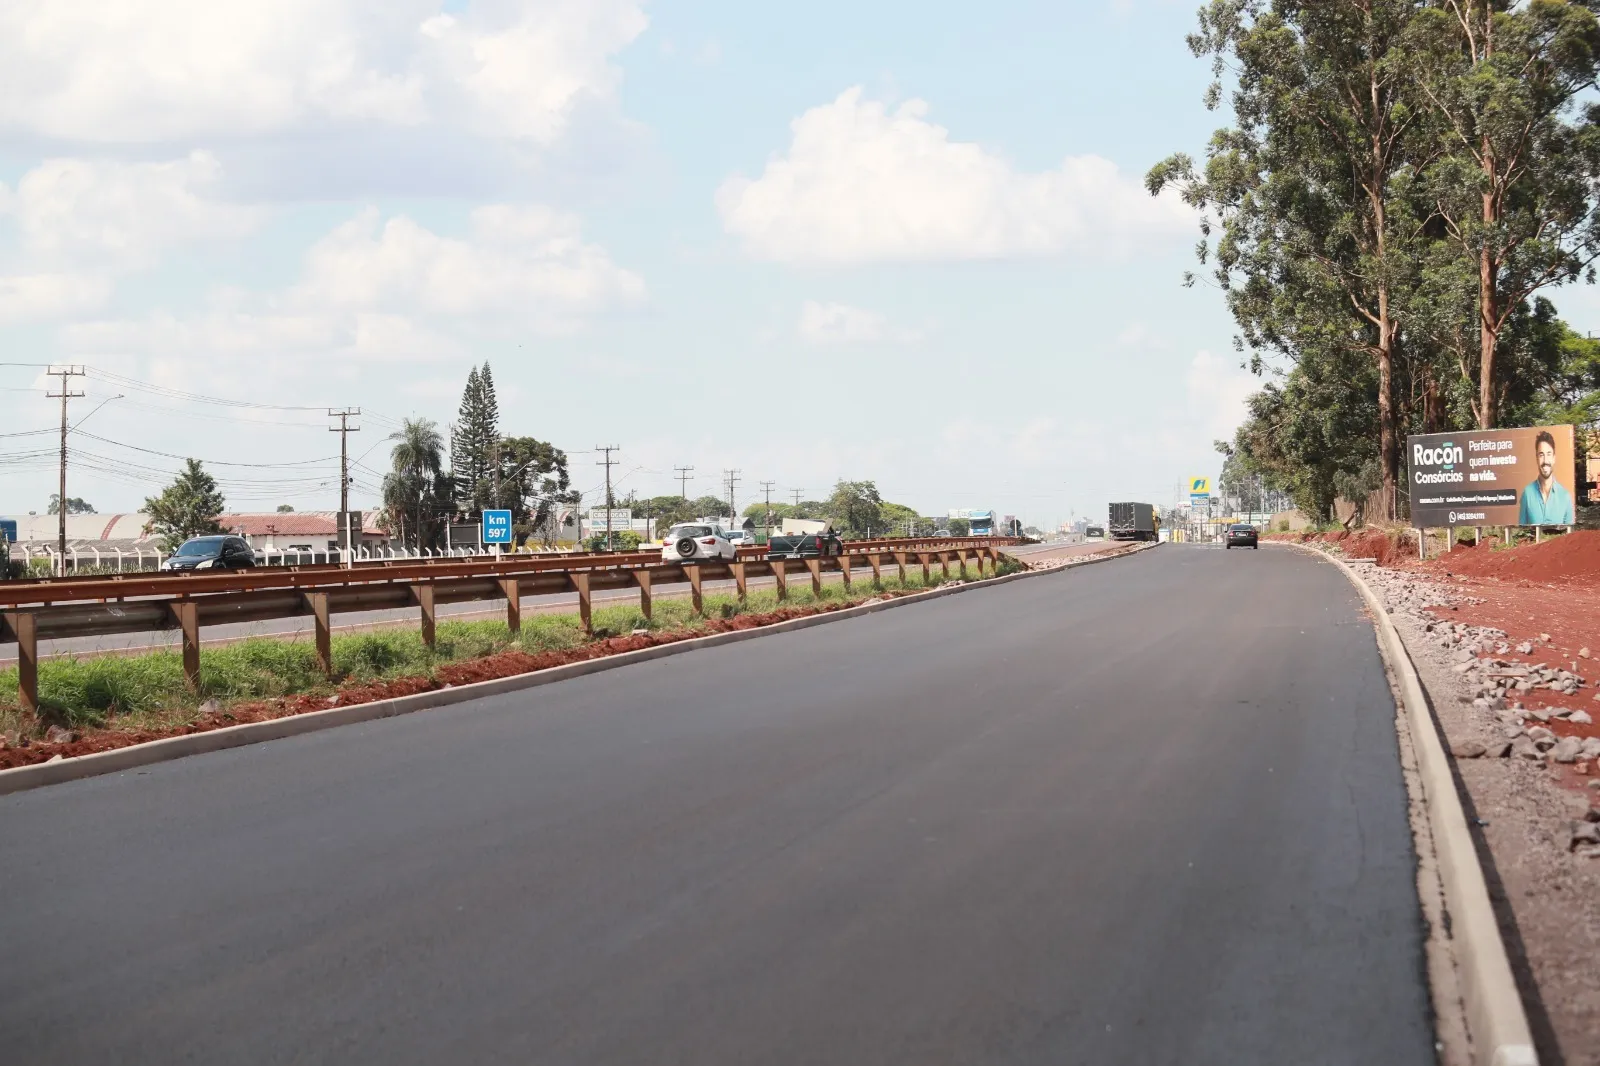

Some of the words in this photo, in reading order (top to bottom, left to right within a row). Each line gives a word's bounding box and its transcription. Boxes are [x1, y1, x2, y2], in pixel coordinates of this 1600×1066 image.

[1468, 440, 1496, 452] Perfeita
[1497, 440, 1513, 453] para
[1413, 443, 1463, 466] Racon
[1469, 457, 1489, 469] quem
[1489, 454, 1517, 466] investe
[1414, 470, 1464, 484] Consórcios
[1469, 472, 1479, 481] na
[1479, 469, 1497, 481] vida.
[488, 515, 506, 525] km
[488, 528, 506, 538] 597
